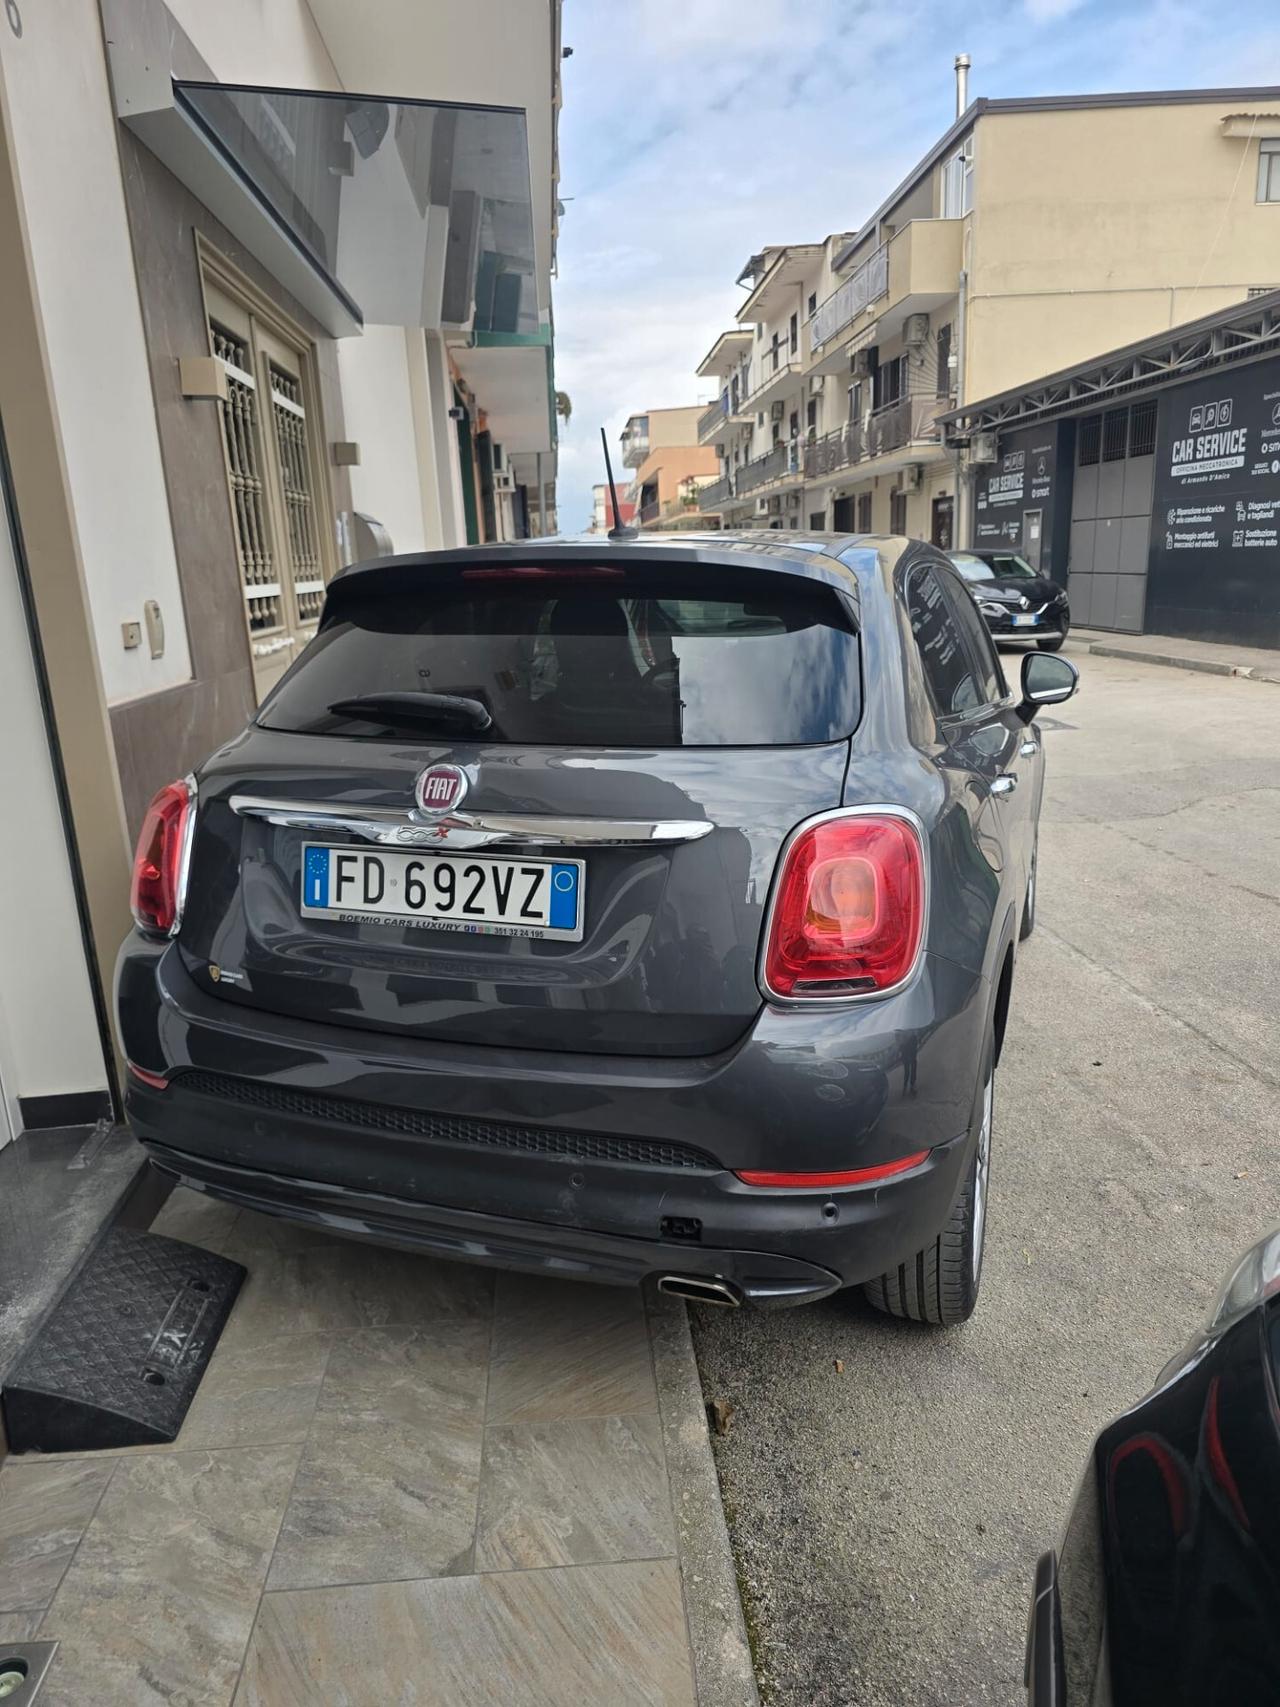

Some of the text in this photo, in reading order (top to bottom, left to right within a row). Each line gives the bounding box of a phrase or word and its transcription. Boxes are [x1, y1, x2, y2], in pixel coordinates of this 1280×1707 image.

[1171, 428, 1247, 463] CAR SERVICE
[1176, 458, 1238, 474] OFFICINA MECCATRONICA
[989, 472, 1024, 493] CAR SERVICE
[1209, 473, 1230, 481] D'Amico
[1248, 501, 1270, 511] Diagnosi
[1252, 510, 1274, 520] tagliandi
[1245, 529, 1277, 538] Sostituzione
[1244, 538, 1278, 547] batterie auto
[425, 777, 457, 801] FIAT
[336, 854, 545, 919] FD 692VZ
[338, 913, 461, 931] BOEMIO CARS LUXURY
[509, 928, 518, 936] 32
[520, 929, 529, 937] 24
[530, 930, 544, 938] 195
